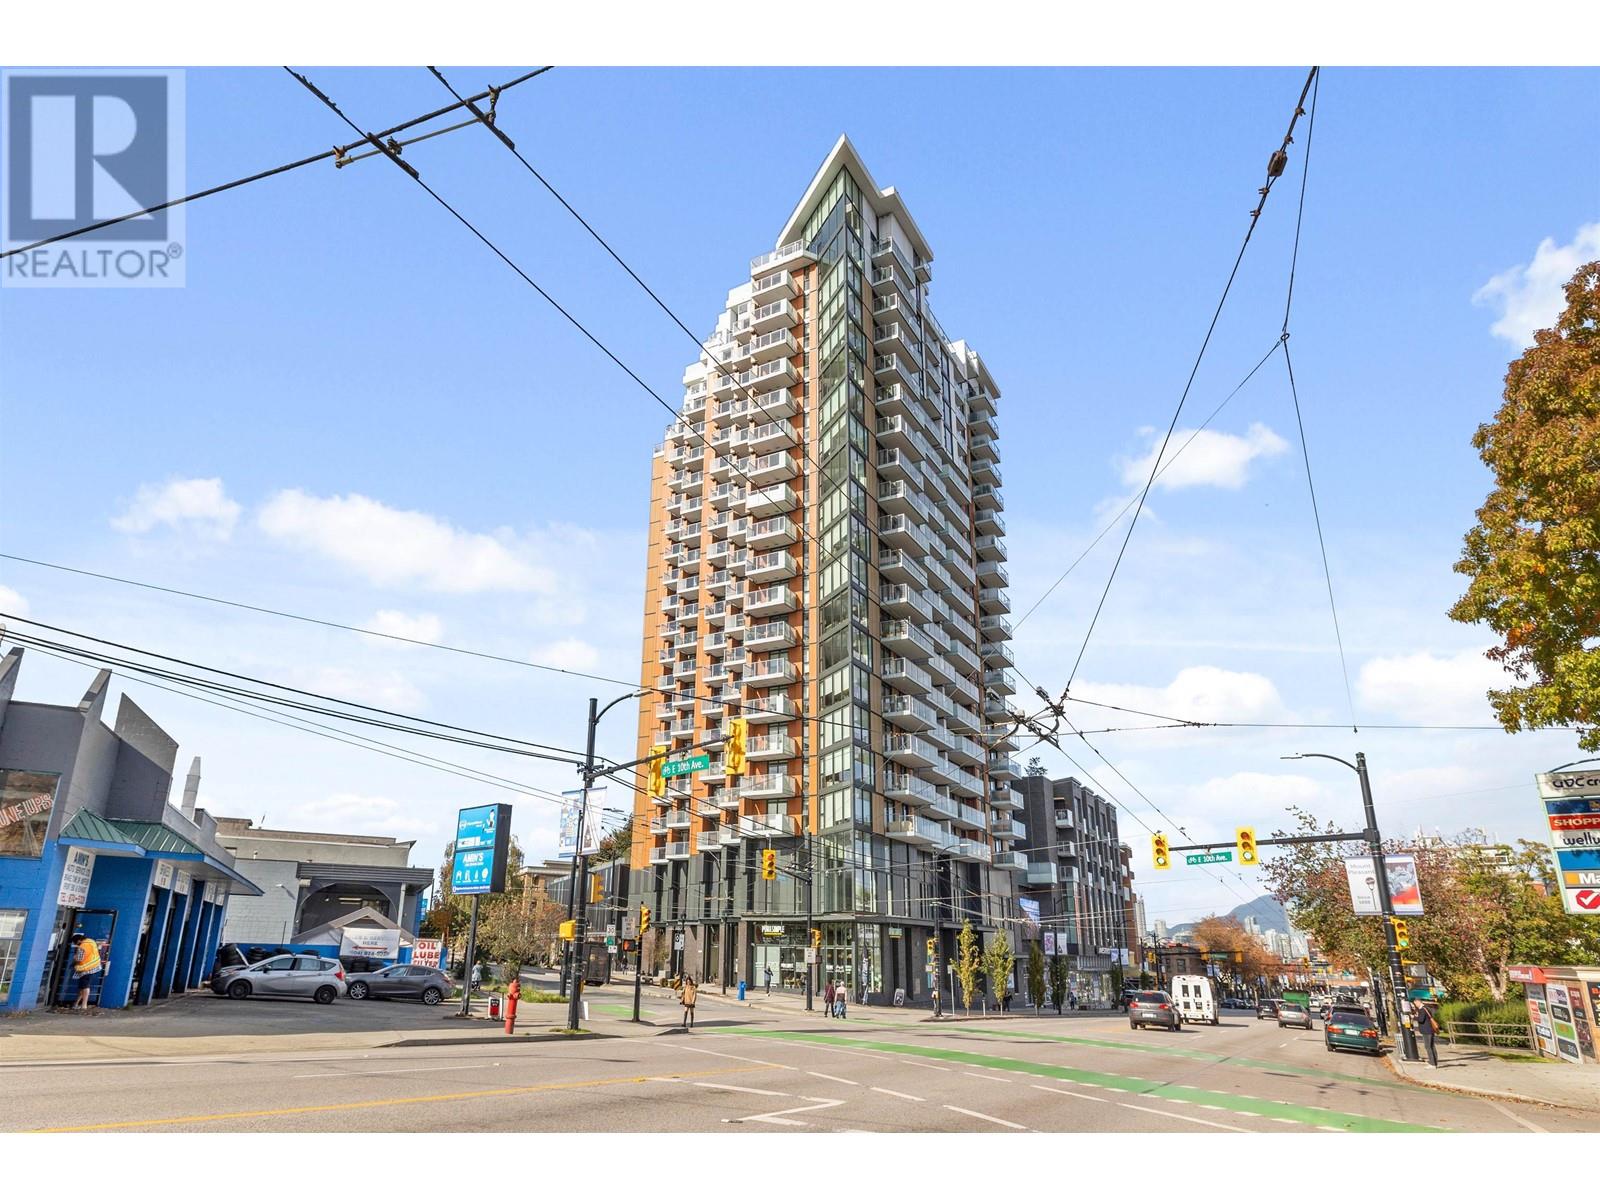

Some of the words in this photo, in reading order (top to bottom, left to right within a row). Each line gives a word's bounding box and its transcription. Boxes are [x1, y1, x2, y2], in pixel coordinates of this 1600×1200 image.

[677, 763, 690, 773] 10th
[691, 760, 704, 770] Ave.
[1203, 855, 1215, 863] 10th
[418, 942, 436, 950] OIL
[413, 951, 440, 959] LUBE
